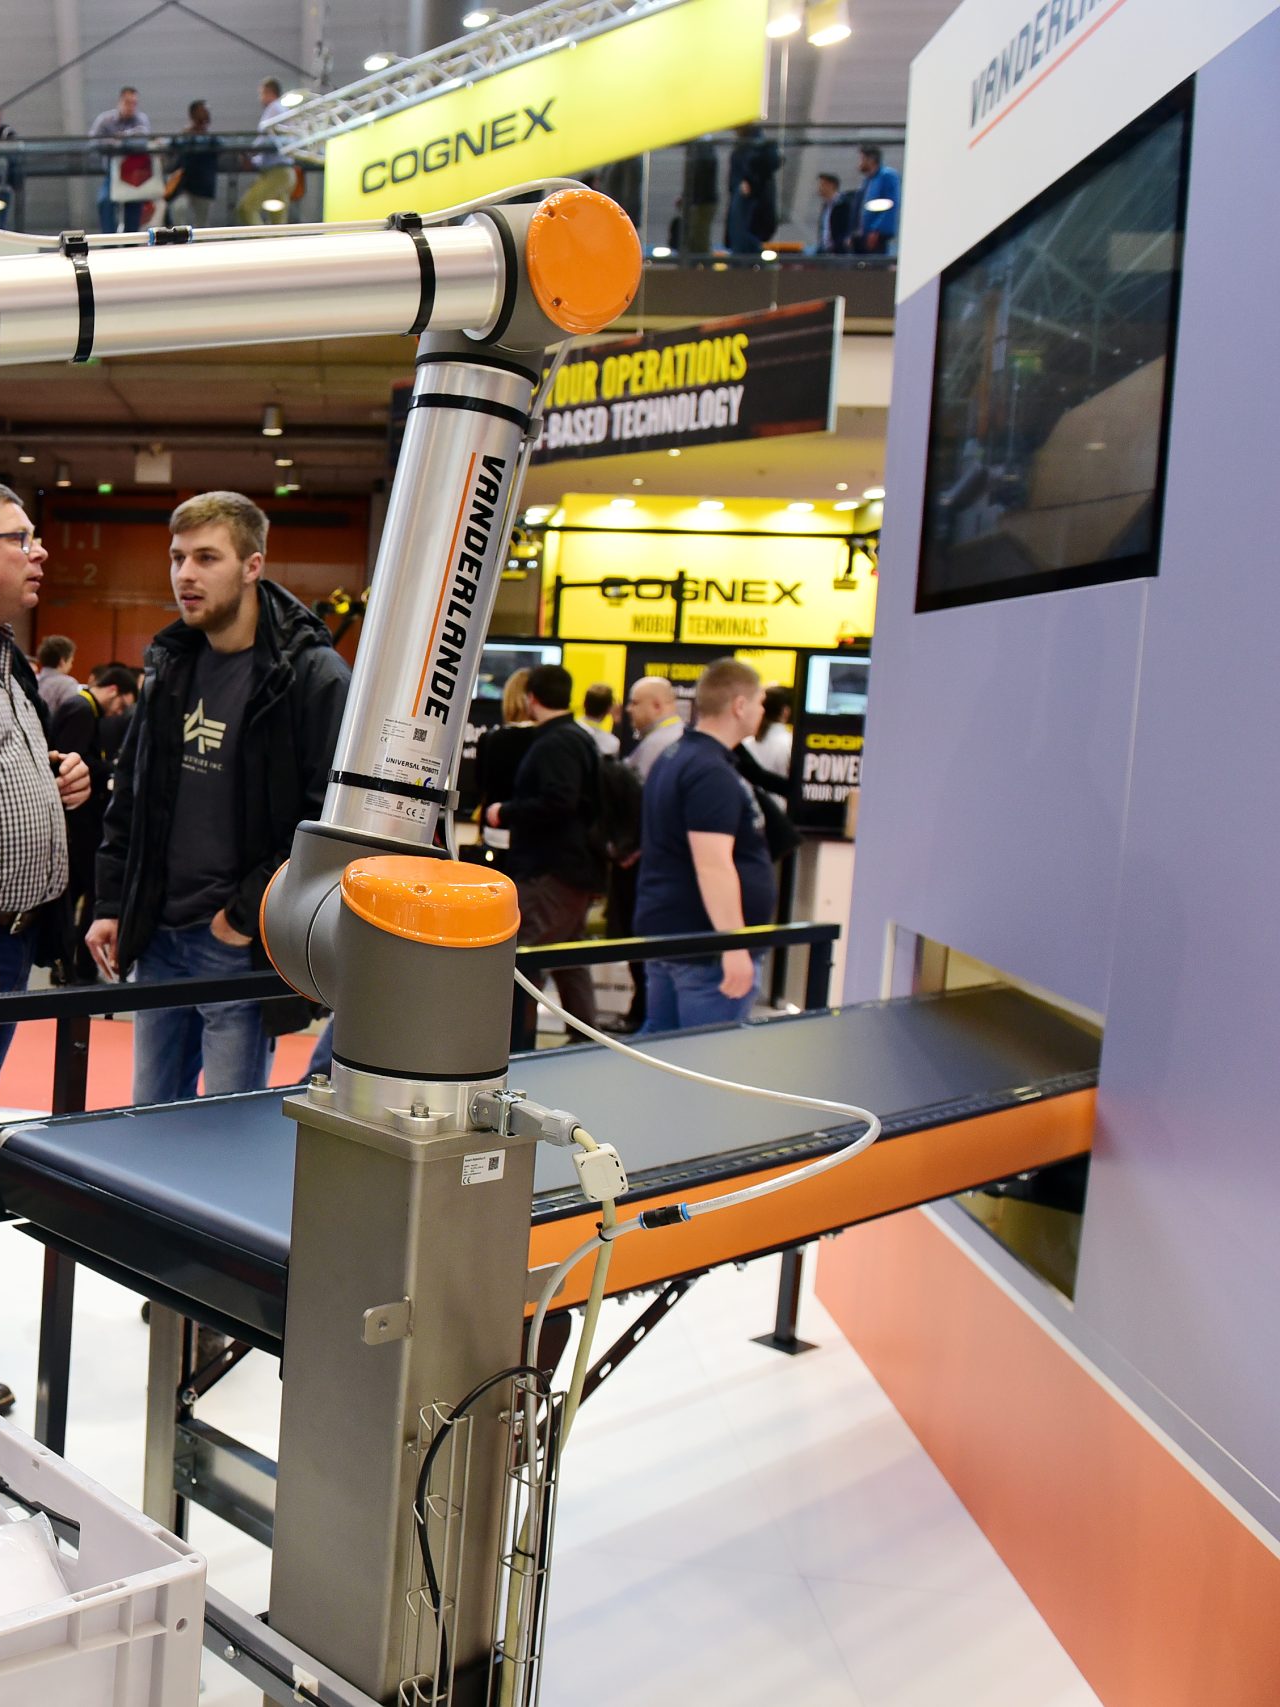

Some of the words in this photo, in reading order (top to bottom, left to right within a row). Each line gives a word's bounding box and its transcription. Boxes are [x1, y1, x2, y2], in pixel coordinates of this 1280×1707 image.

[970, 0, 1104, 128] VANDERL
[361, 97, 556, 194] COGNEX
[601, 333, 750, 400] OPERATIONS
[611, 385, 745, 441] TECHNOLOGY
[424, 454, 507, 726] VANDERLANDE
[600, 577, 803, 606] COGNEX
[632, 613, 676, 635] MOBIL
[687, 616, 769, 638] TERMINALS
[385, 757, 420, 770] UNIVERSAL
[421, 765, 439, 776] ROBOTS
[802, 752, 864, 784] POWE
